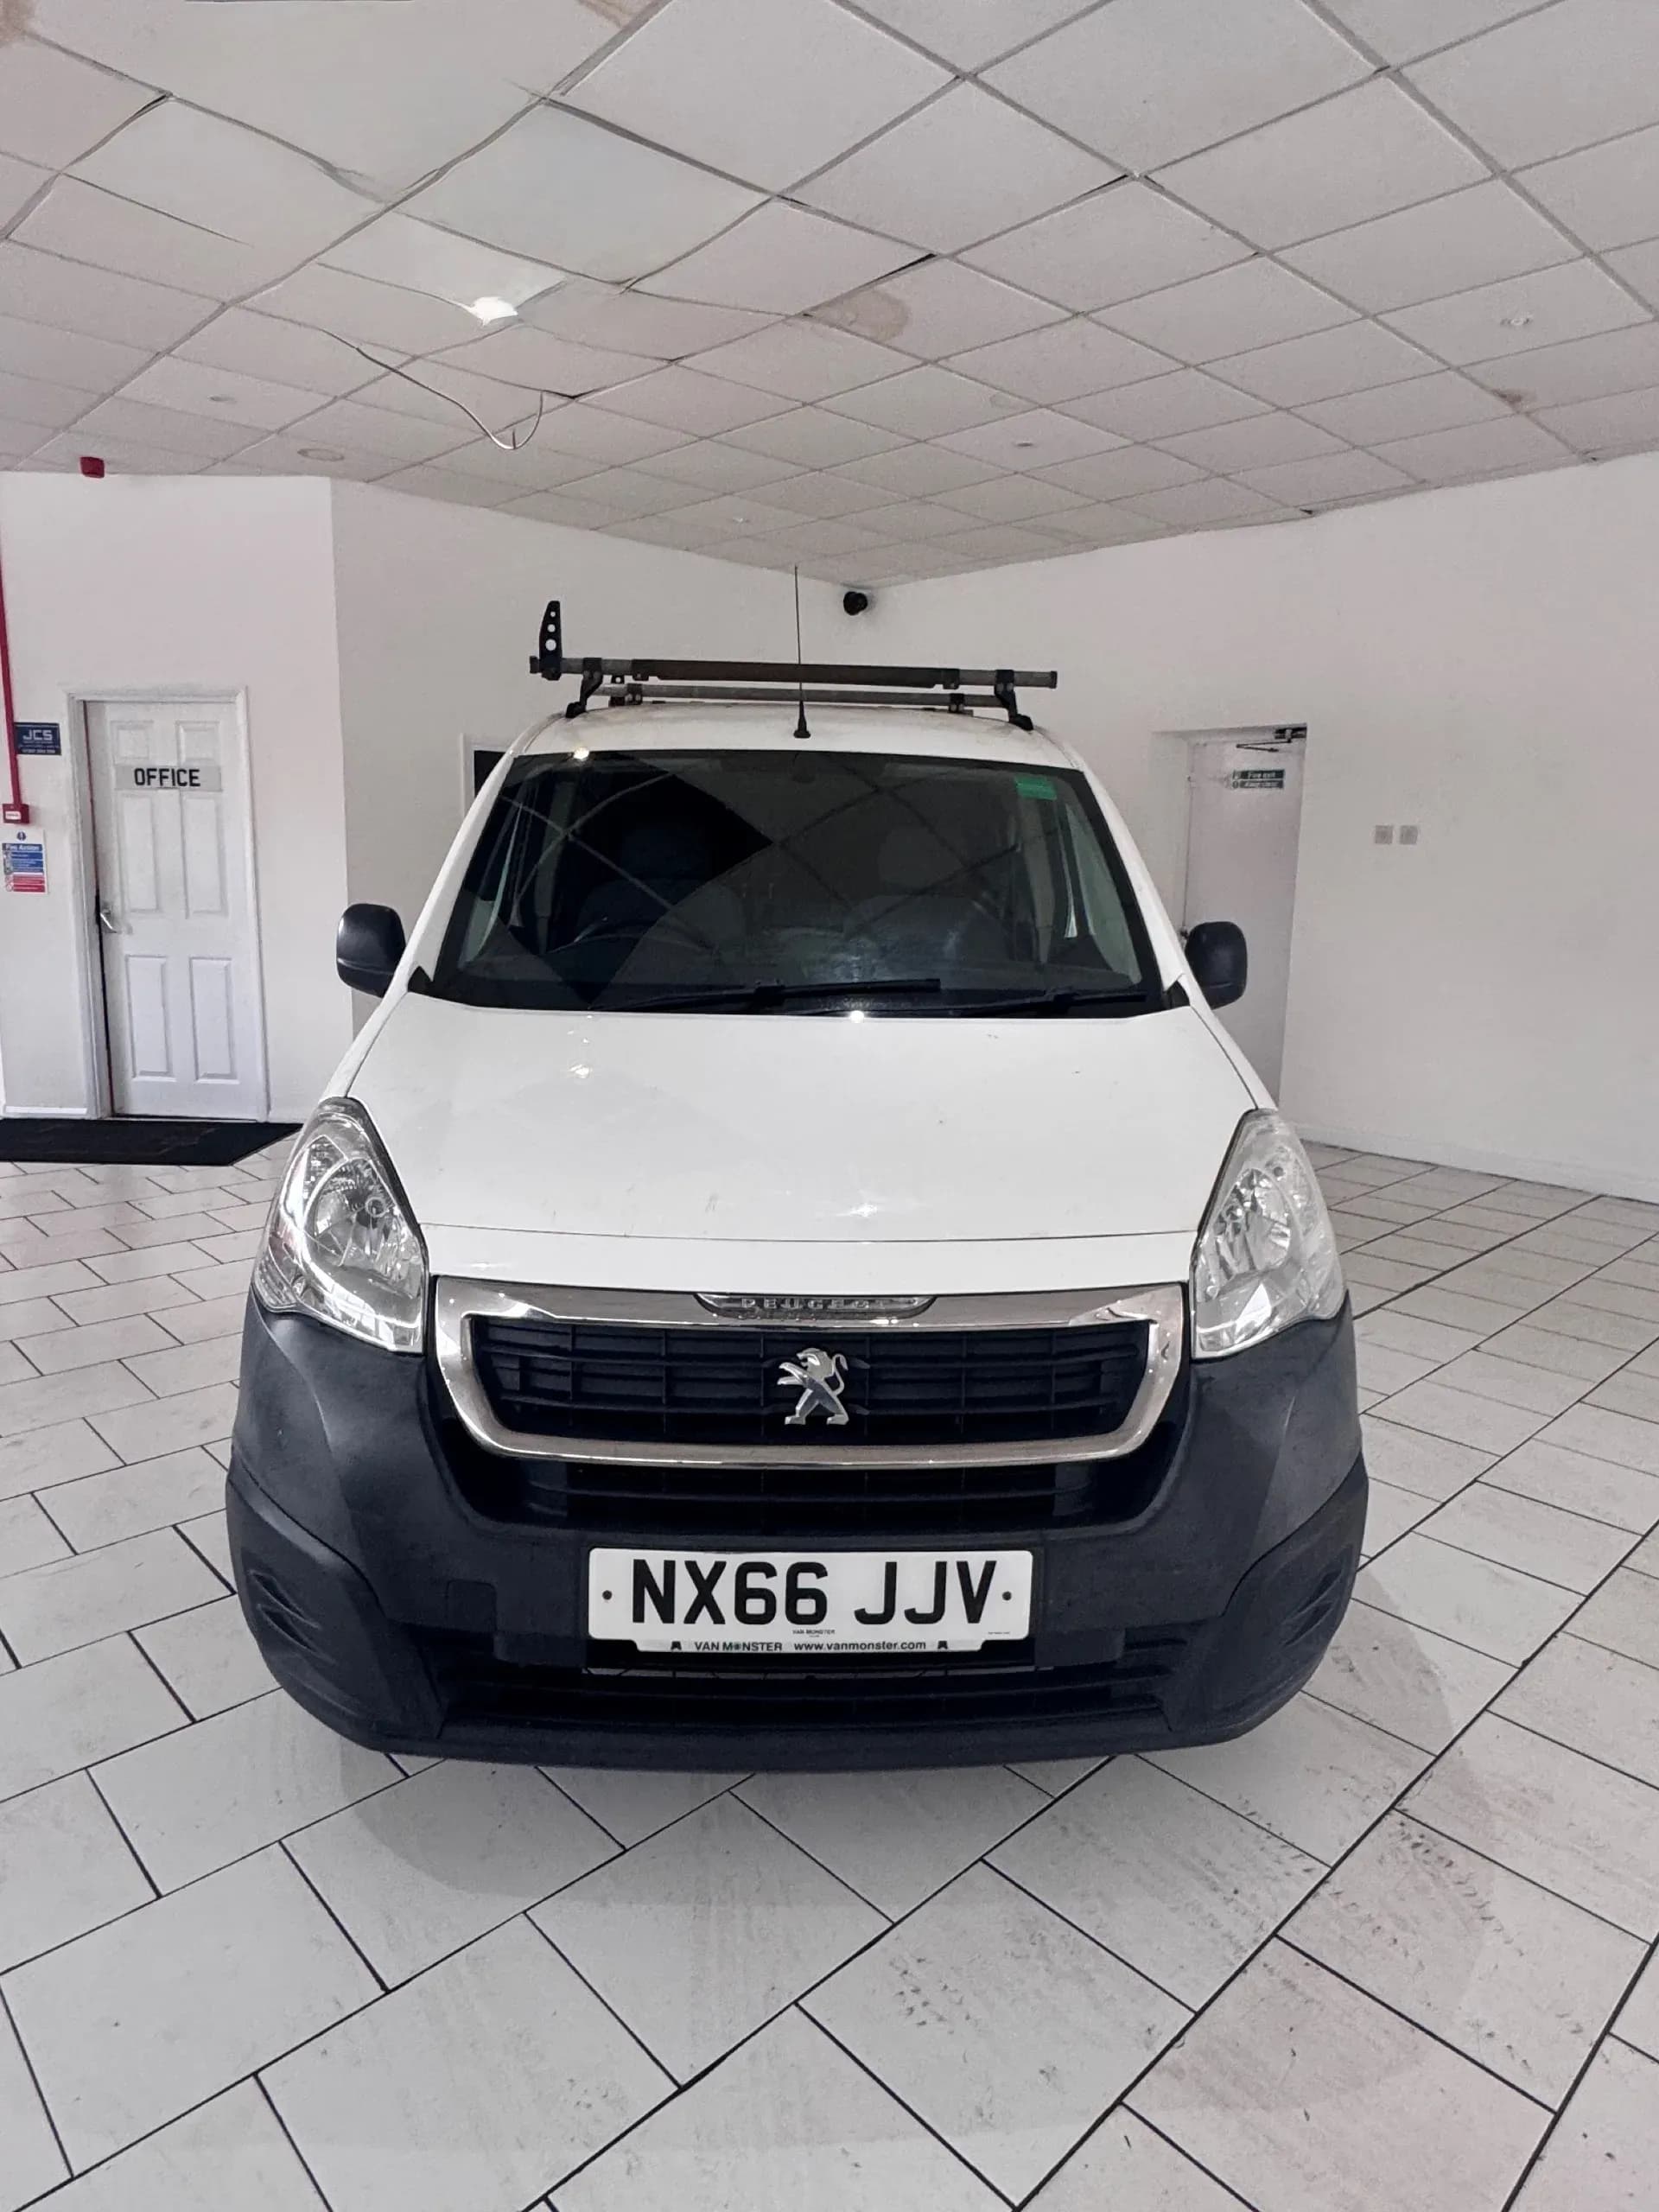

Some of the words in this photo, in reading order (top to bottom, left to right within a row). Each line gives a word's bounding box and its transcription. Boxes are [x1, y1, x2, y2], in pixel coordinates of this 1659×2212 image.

[22, 729, 53, 741] JCS
[134, 767, 200, 787] OFFICE
[632, 1559, 828, 1624] NX66
[854, 1560, 997, 1624] JJV
[695, 1642, 720, 1651] VAN
[794, 1641, 926, 1651] www.vanmonster.com
